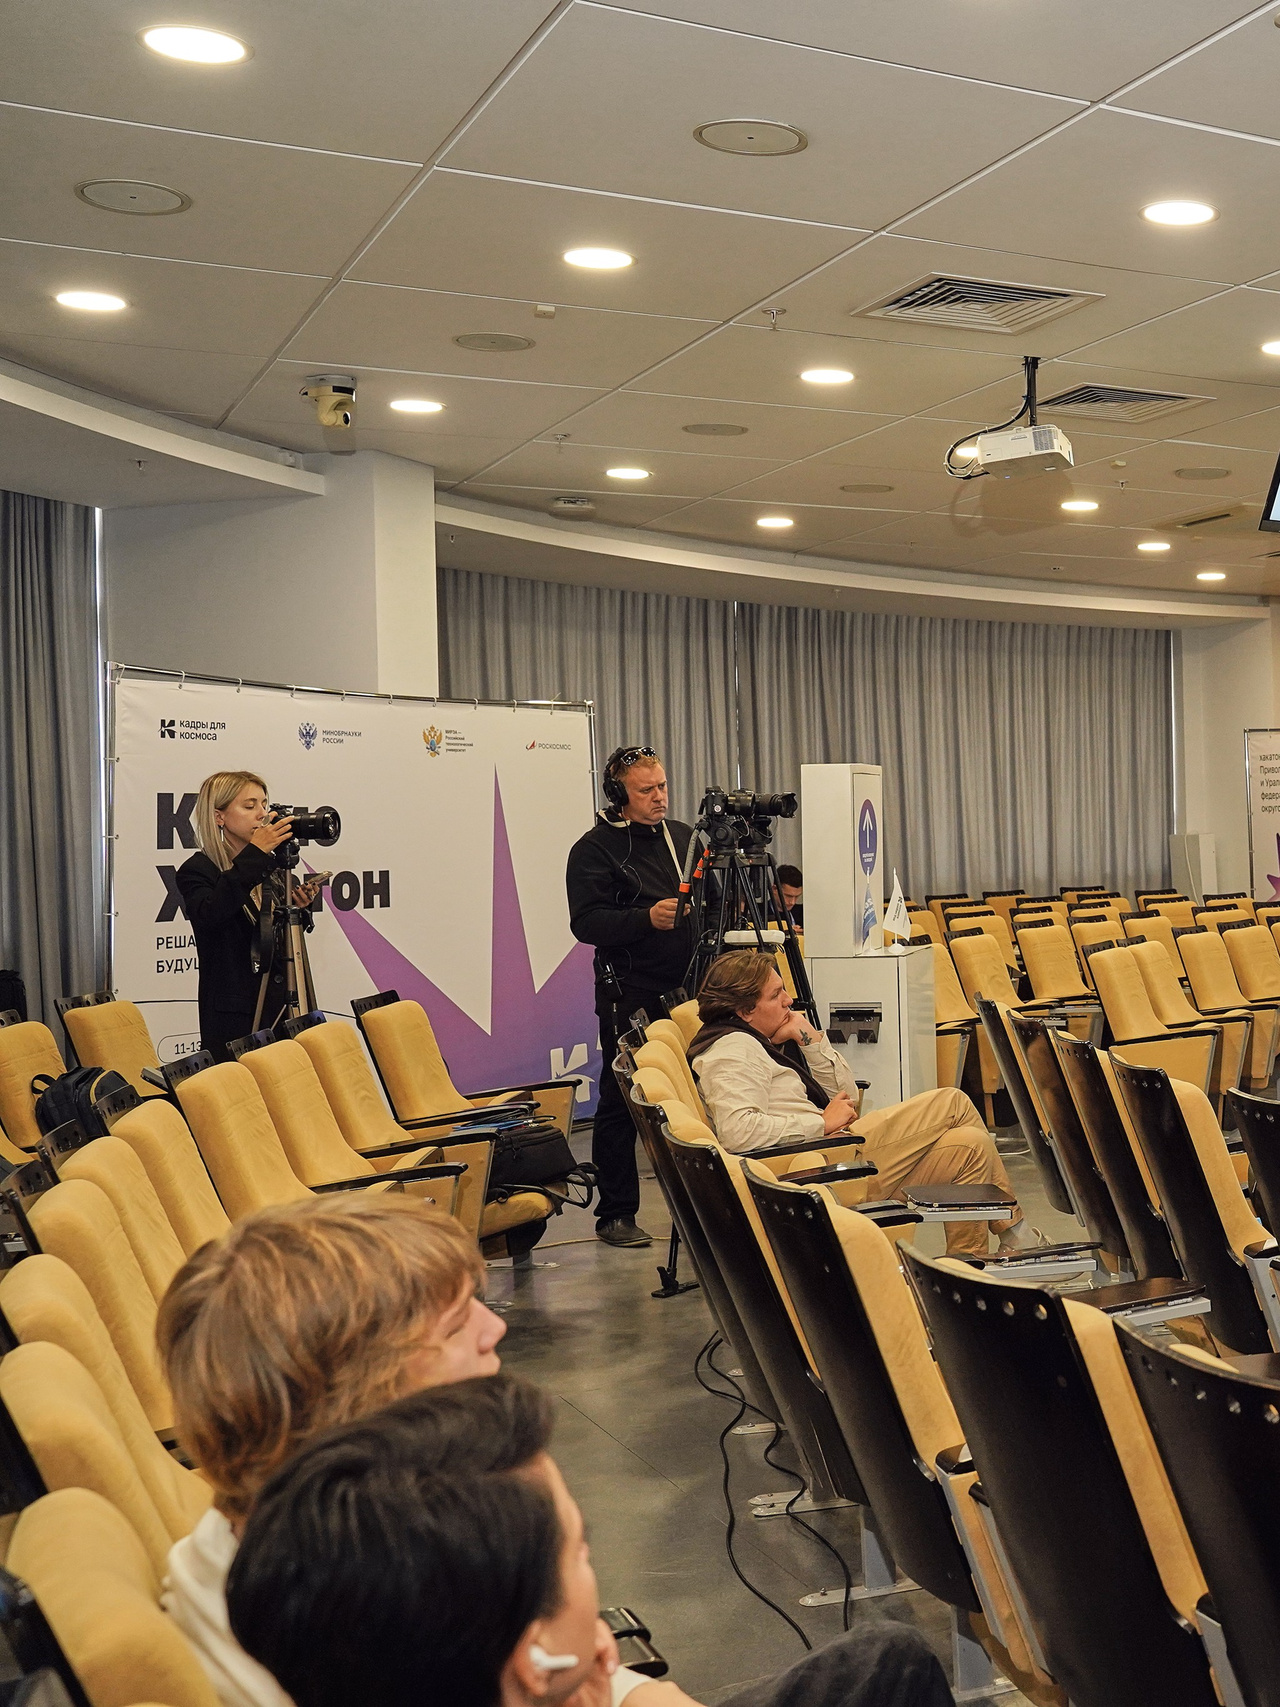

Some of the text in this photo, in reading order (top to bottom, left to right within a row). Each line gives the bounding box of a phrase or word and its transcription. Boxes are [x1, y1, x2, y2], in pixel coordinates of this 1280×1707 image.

[180, 719, 226, 730] кадры для
[180, 732, 217, 741] космоса
[156, 936, 197, 950] РЕША
[174, 1041, 202, 1055] 11-13
